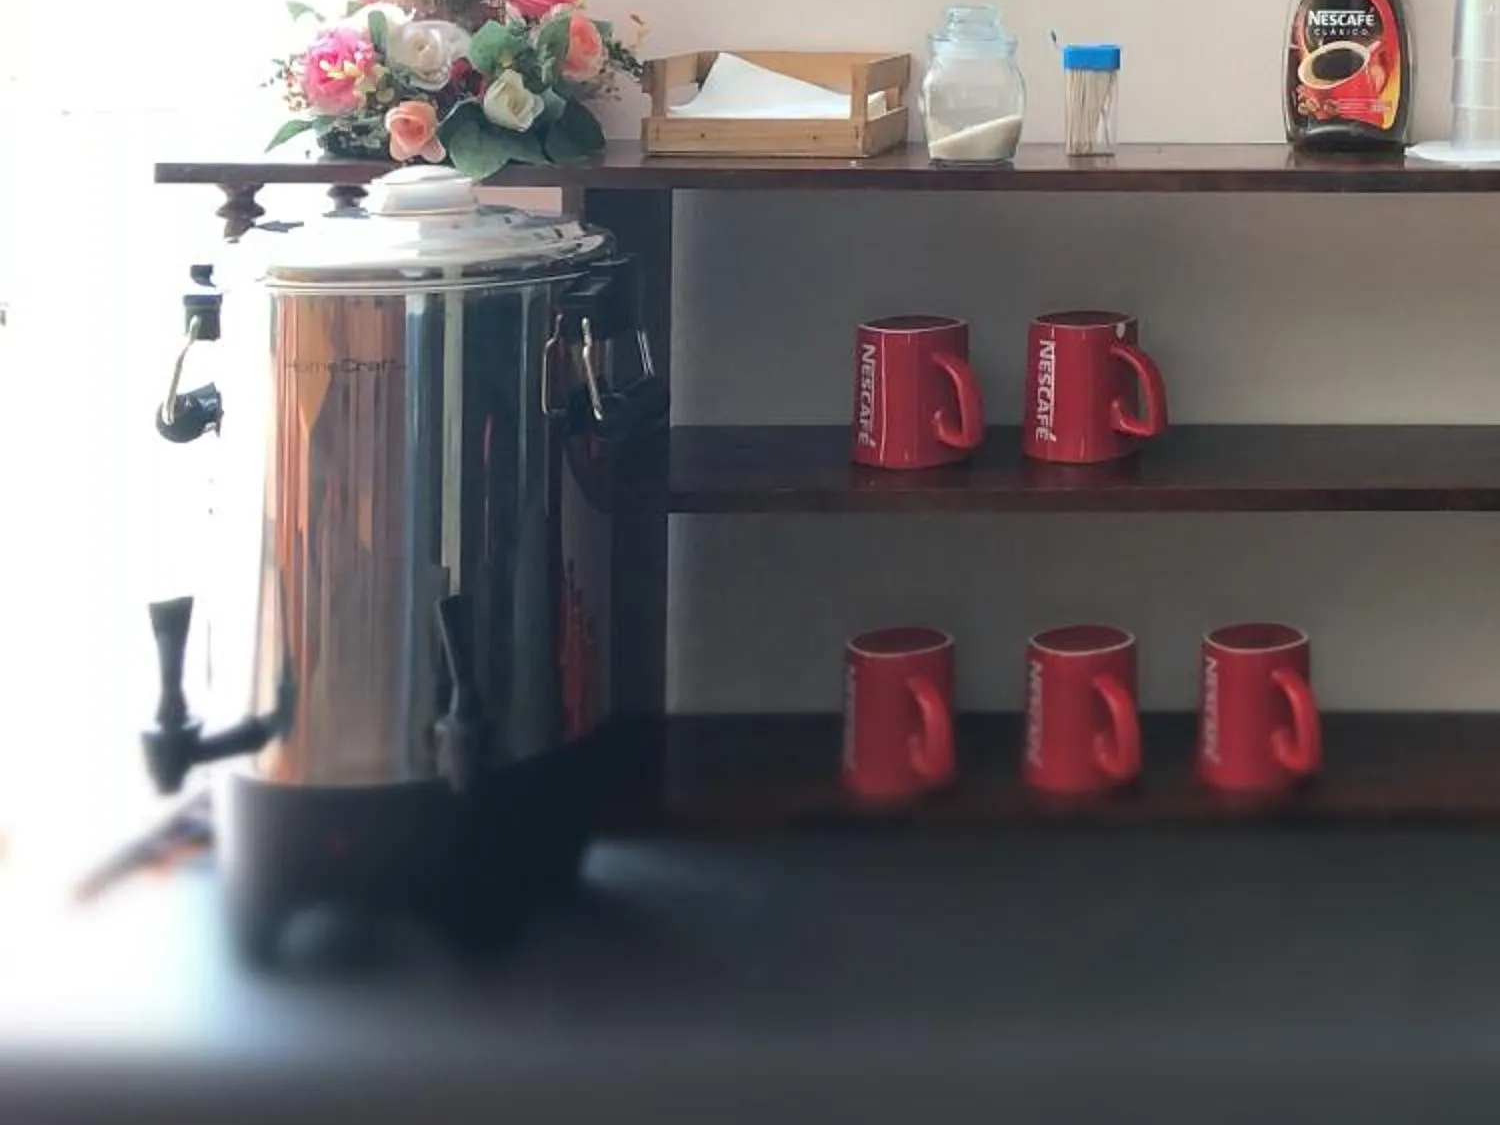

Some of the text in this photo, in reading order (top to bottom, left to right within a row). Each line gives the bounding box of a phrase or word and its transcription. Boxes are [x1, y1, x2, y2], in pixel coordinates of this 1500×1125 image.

[1308, 7, 1376, 26] NESCAFÉ
[859, 343, 876, 448] NESCAFÉ
[1036, 339, 1057, 445] NESCAFÉ
